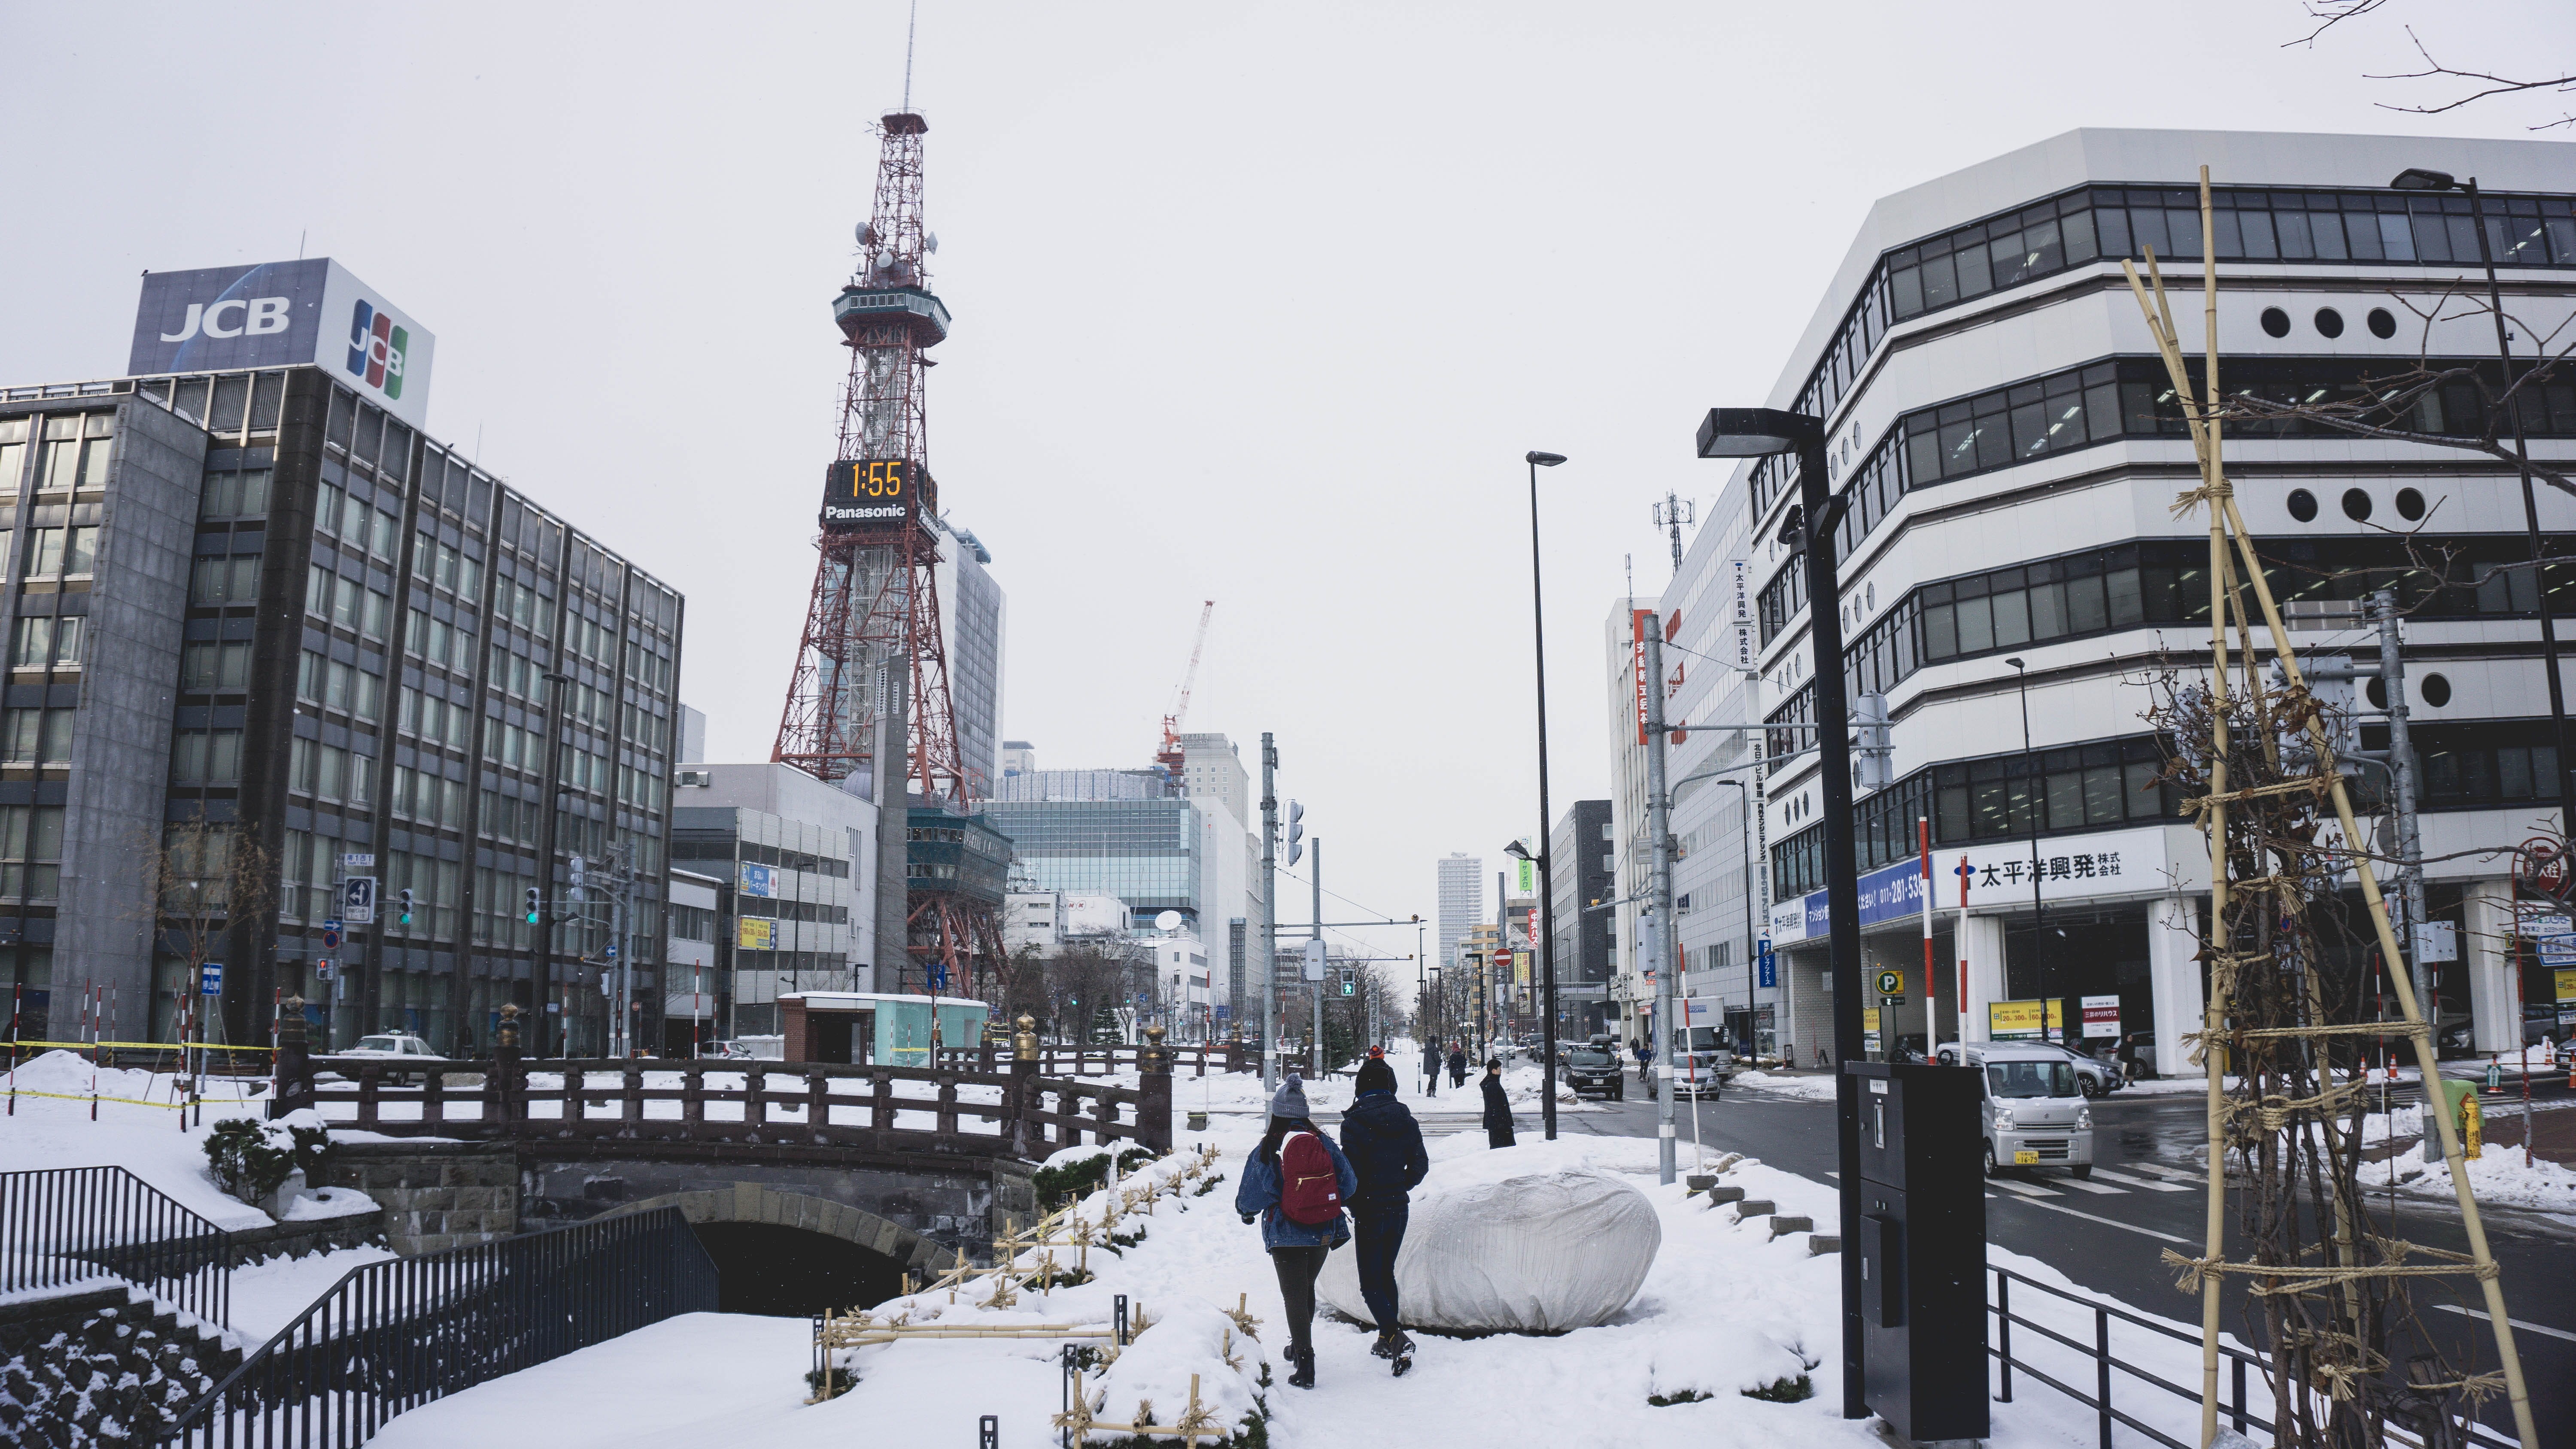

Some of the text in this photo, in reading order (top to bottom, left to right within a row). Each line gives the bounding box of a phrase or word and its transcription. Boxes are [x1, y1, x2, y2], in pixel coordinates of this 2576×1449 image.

[160, 297, 290, 342] JCB
[350, 327, 403, 377] JCB
[853, 462, 901, 497] 1:55
[826, 504, 905, 518] Panasonic
[919, 508, 941, 540] Panasonic
[1736, 574, 1749, 664] 太平洋興発 株式会社
[754, 870, 763, 880] まるい
[1980, 854, 2096, 888] 太平洋興発
[1884, 976, 1895, 990] P
